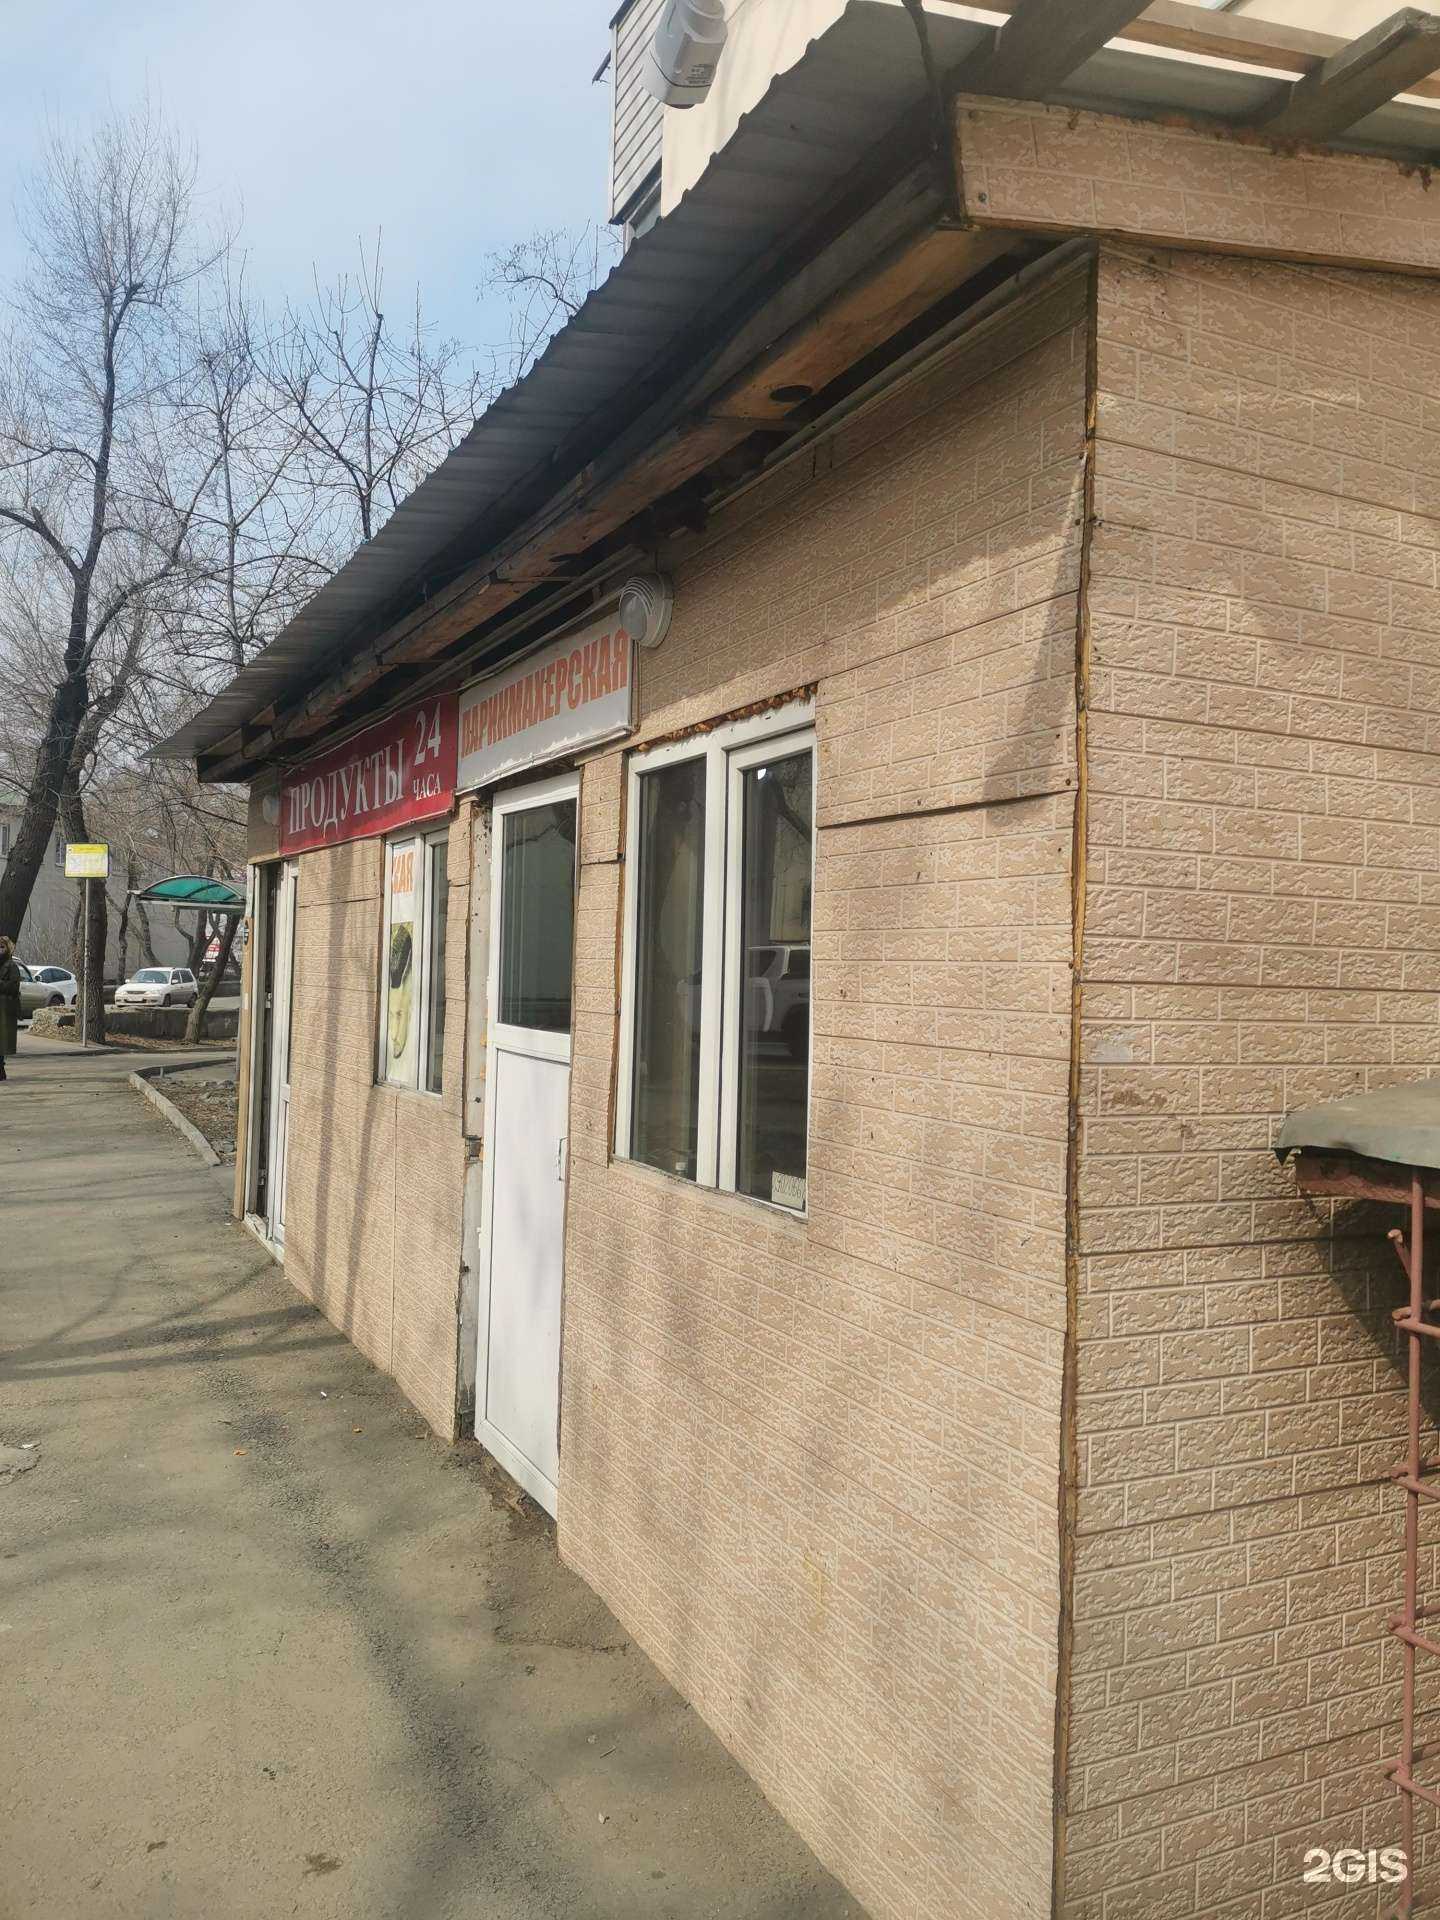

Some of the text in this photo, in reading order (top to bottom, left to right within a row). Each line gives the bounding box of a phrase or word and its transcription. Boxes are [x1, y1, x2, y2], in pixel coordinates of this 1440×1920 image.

[462, 629, 628, 758] ПАРИКМАХЕРСКАЯ
[288, 702, 441, 838] ПРОДУКТЫ 24
[413, 773, 441, 801] ЧАСА
